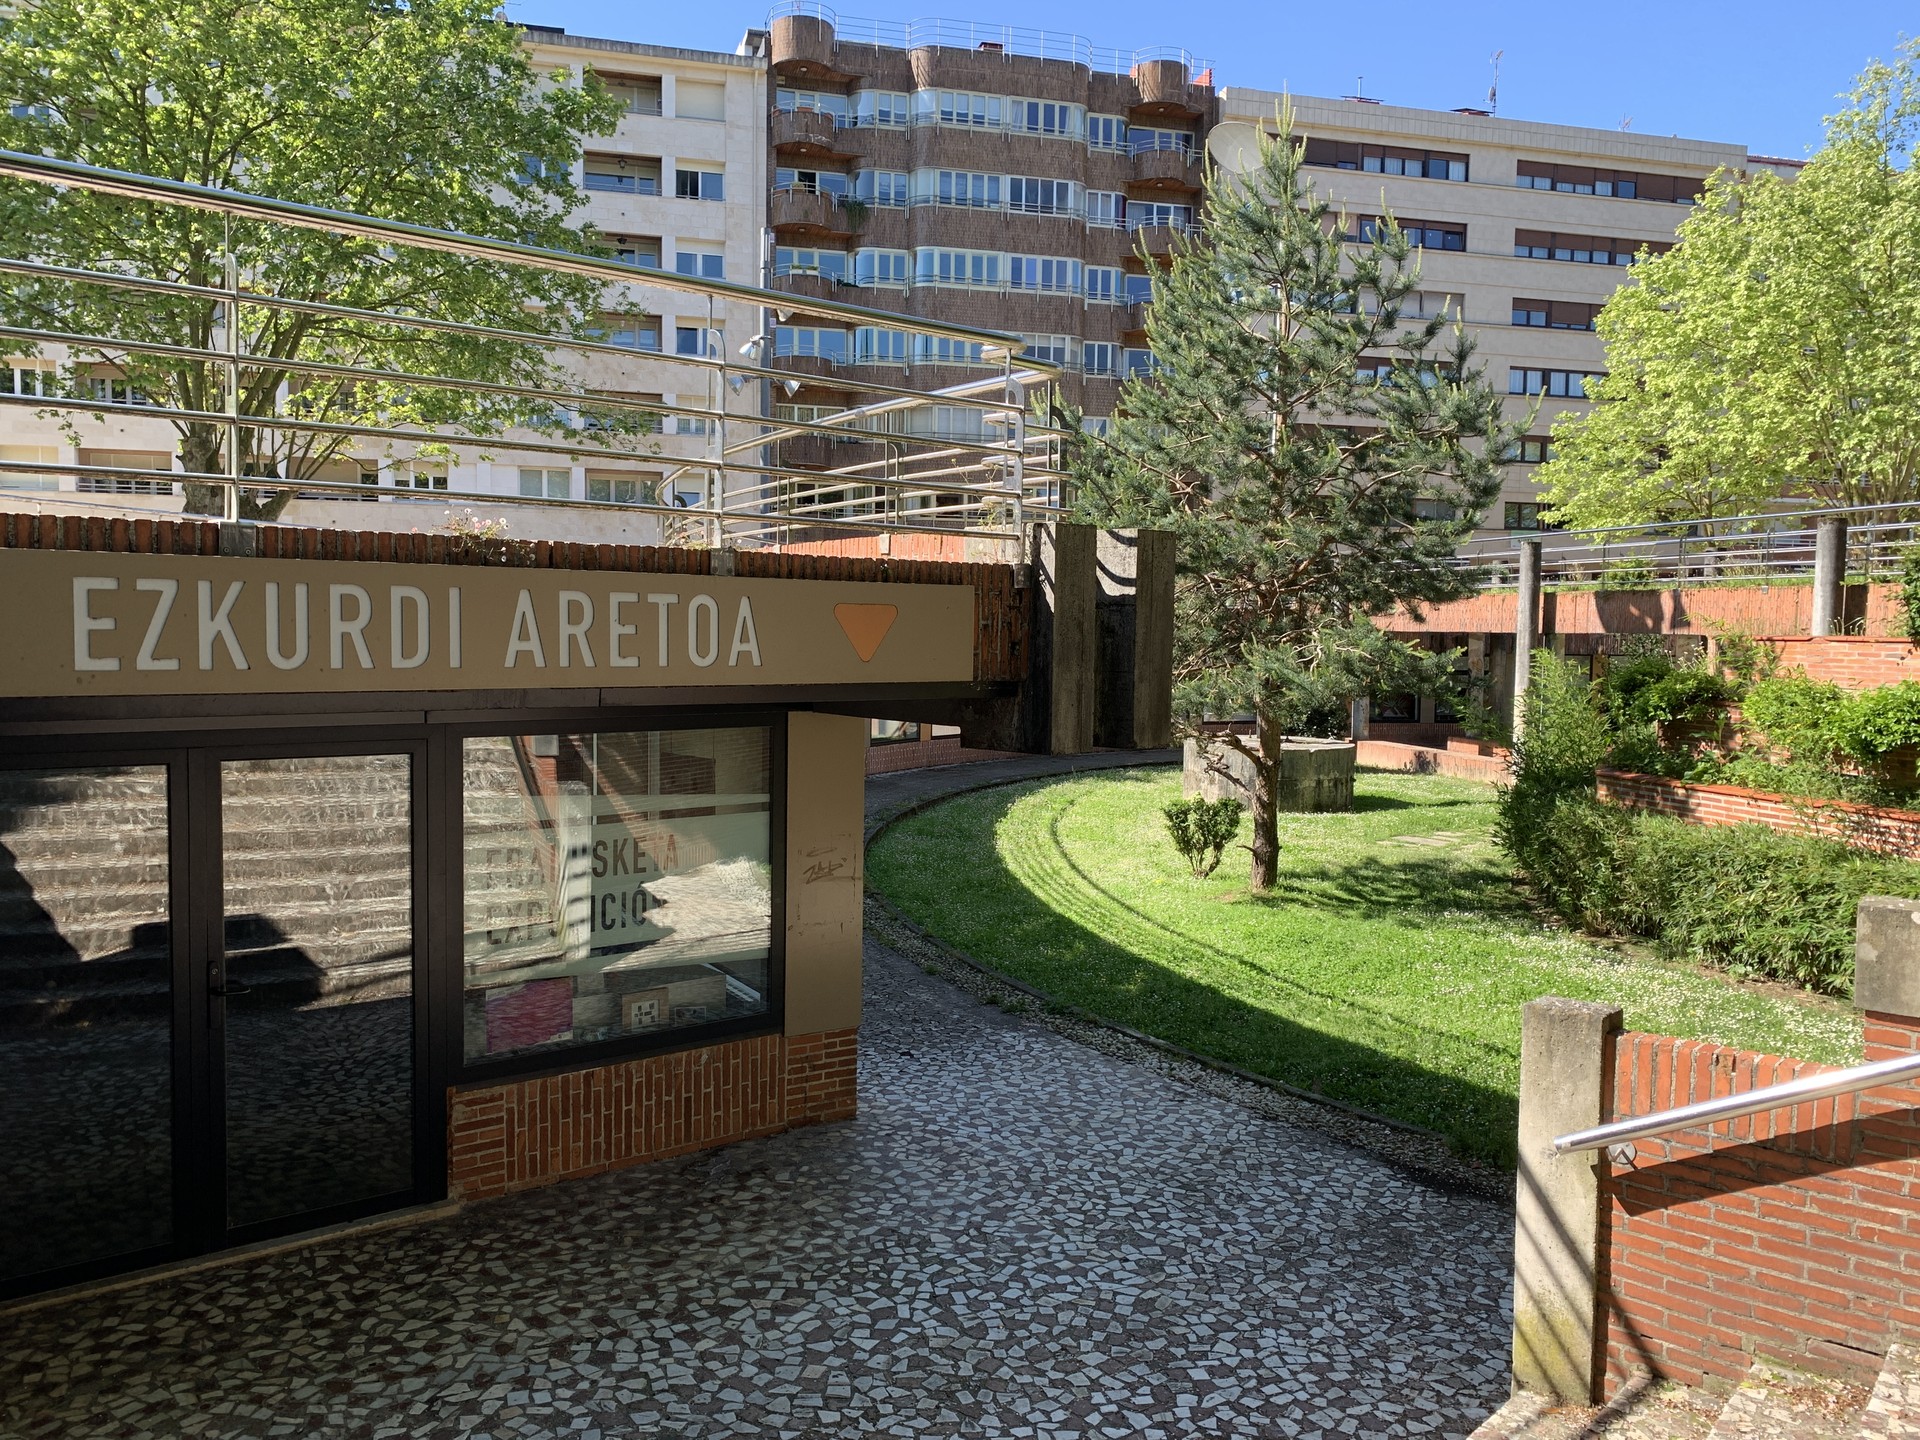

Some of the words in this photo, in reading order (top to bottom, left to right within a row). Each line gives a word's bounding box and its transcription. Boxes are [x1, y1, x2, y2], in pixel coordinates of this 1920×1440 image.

[73, 577, 462, 671] EZKURDI
[504, 588, 762, 668] ARETOA
[486, 834, 679, 889] ERASKETA
